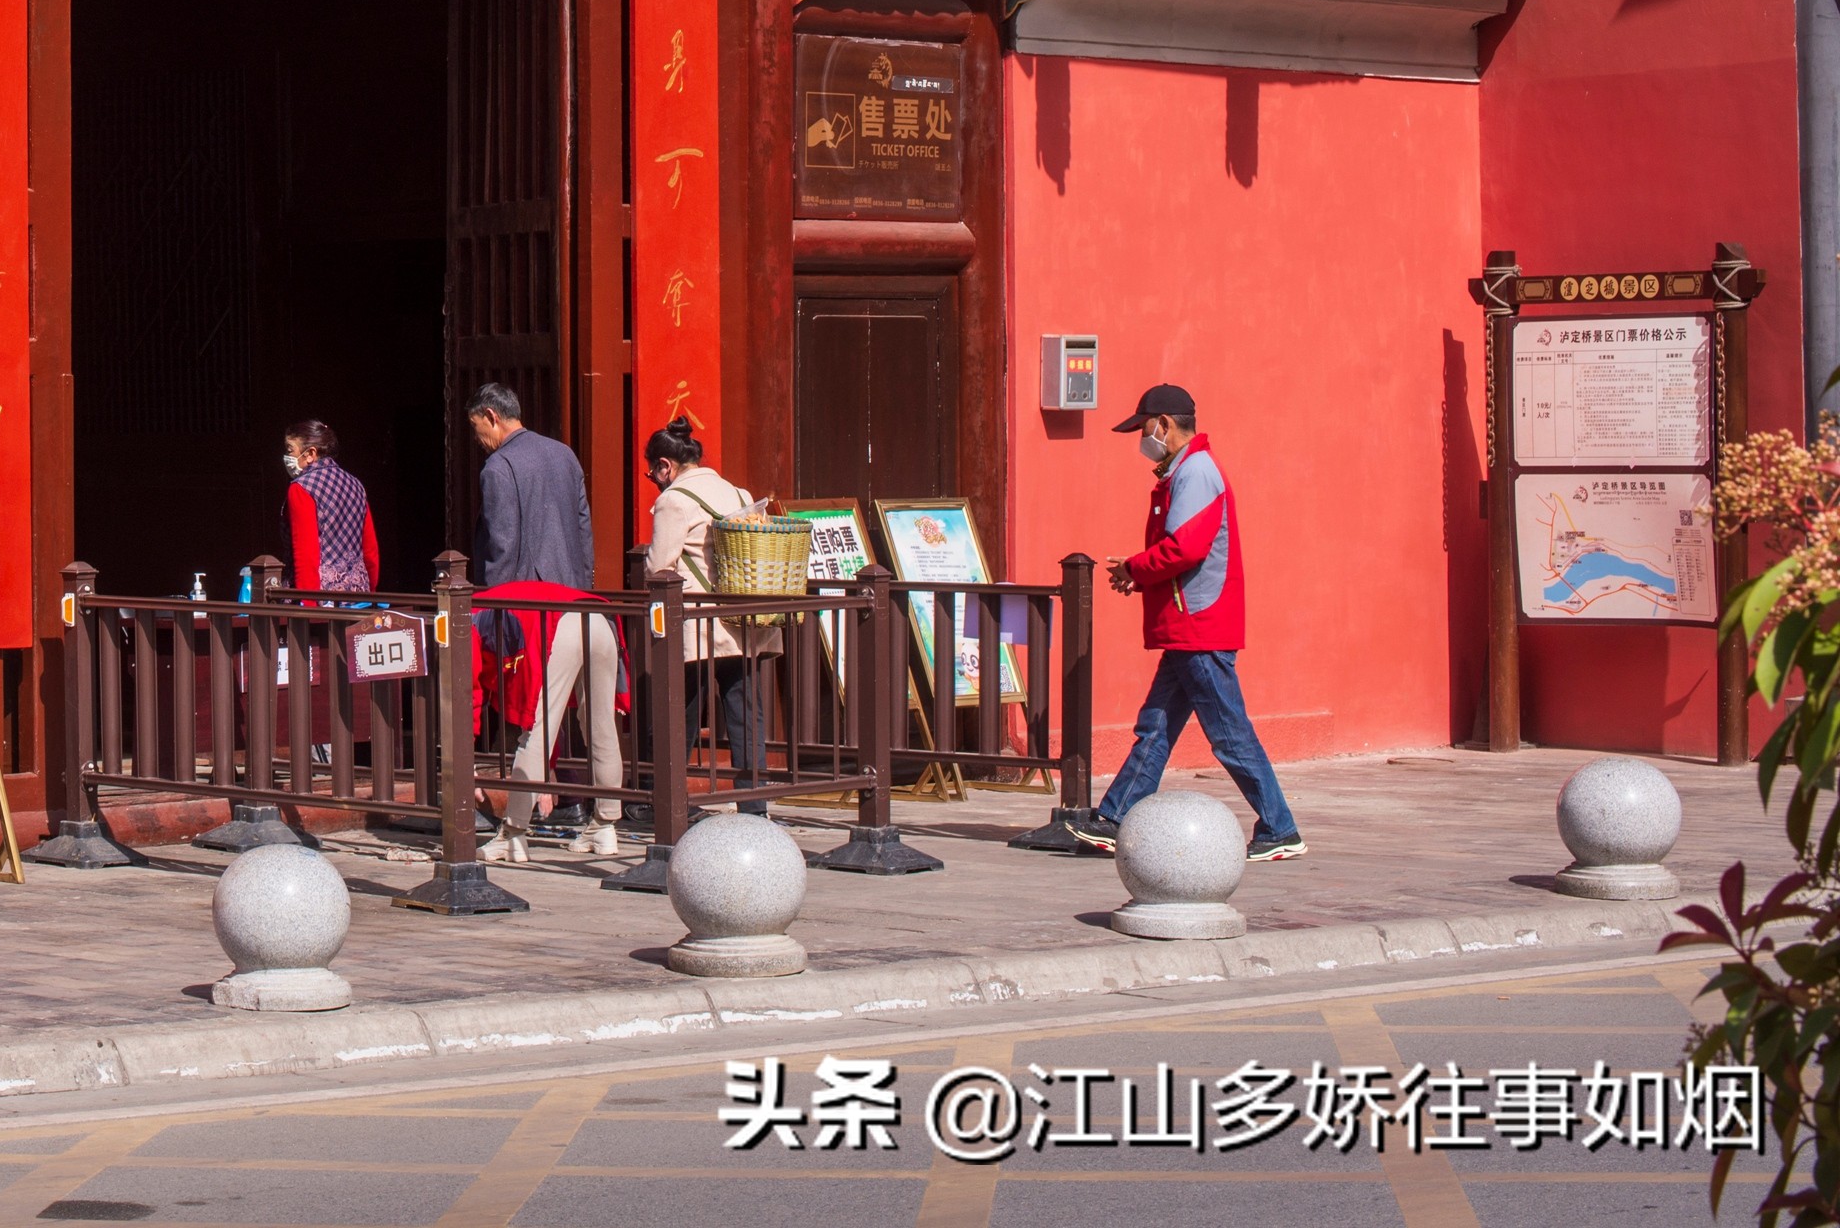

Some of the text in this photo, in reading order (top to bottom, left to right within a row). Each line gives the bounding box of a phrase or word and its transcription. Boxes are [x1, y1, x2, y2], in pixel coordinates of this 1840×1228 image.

[858, 95, 953, 141] 售票处
[871, 143, 940, 159] TICKET OFFICE
[1559, 328, 1687, 344] 泸定桥景区门票价格公示
[1592, 481, 1666, 491] 泸定桥景区导览图
[368, 642, 403, 666] 出口
